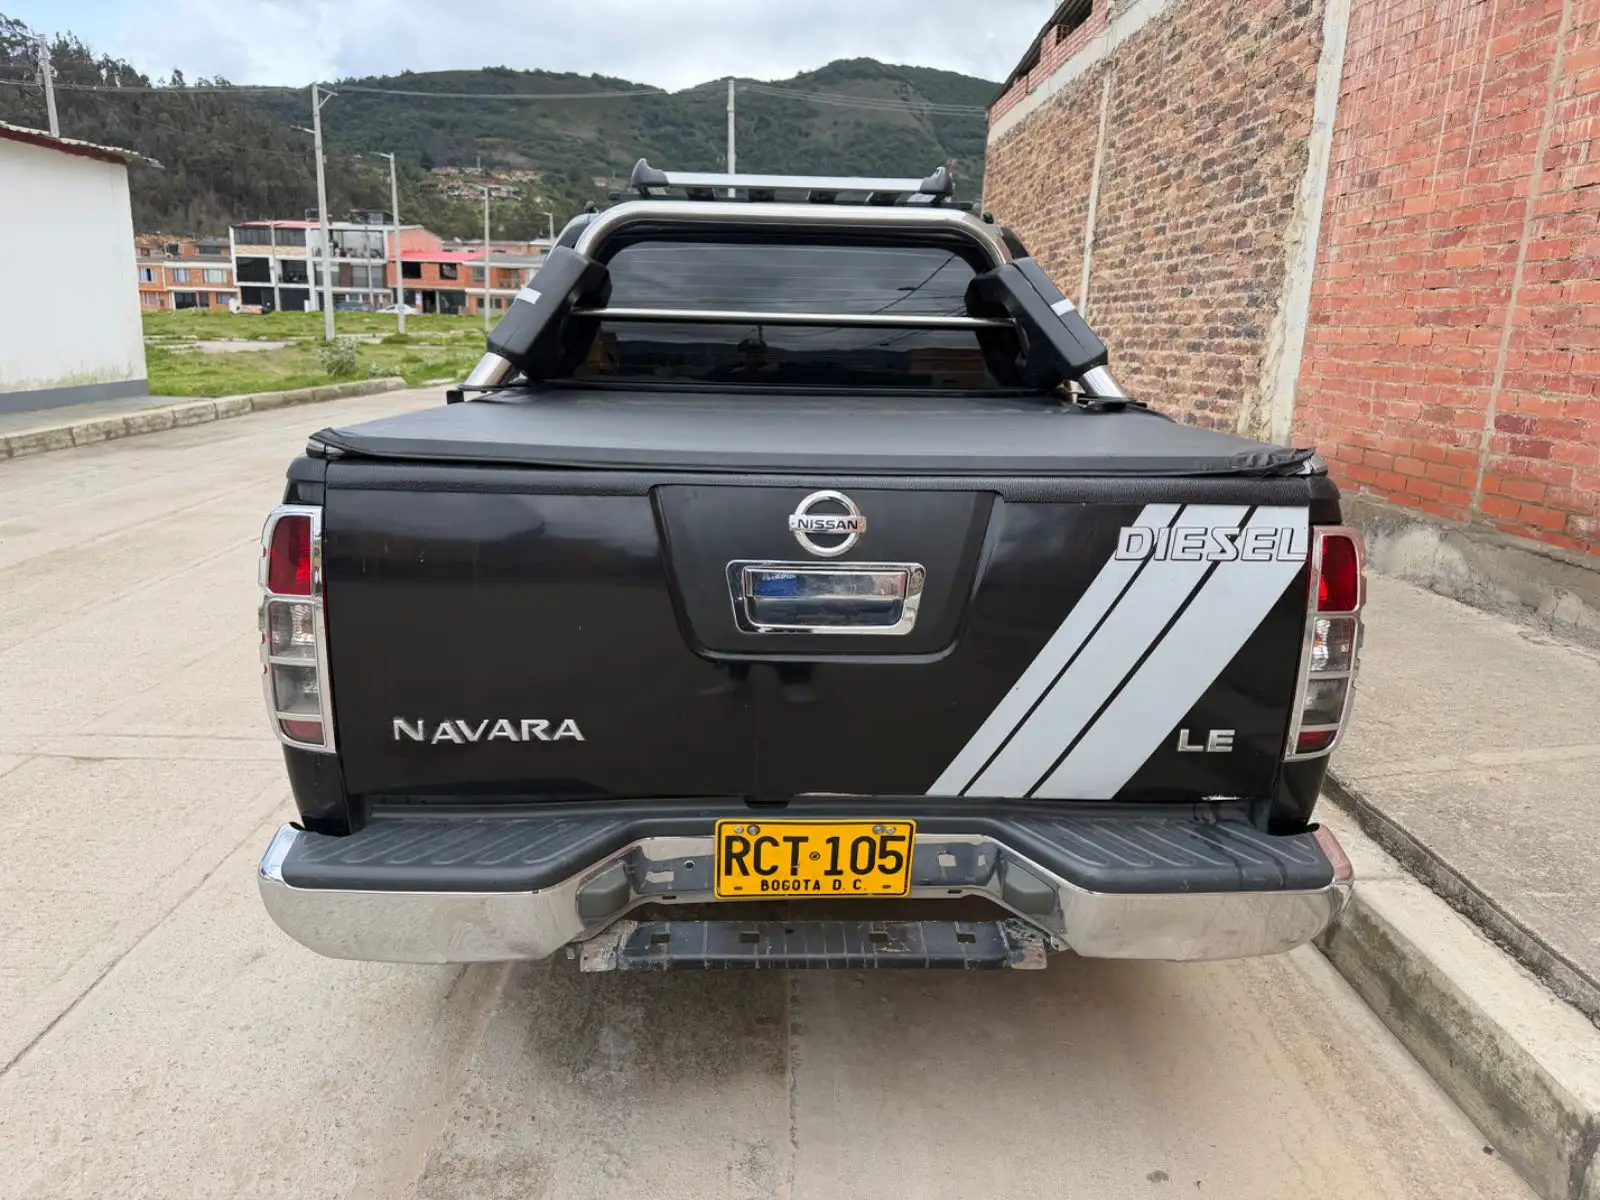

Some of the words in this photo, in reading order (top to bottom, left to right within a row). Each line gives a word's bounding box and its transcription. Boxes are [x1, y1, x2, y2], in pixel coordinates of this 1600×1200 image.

[797, 518, 858, 530] NISSAN
[1115, 526, 1308, 562] DIESEL
[393, 717, 586, 744] NAVARA
[1177, 728, 1235, 752] LE
[724, 835, 809, 876] RCT
[824, 835, 906, 876] 105
[760, 878, 821, 891] BOGOTA
